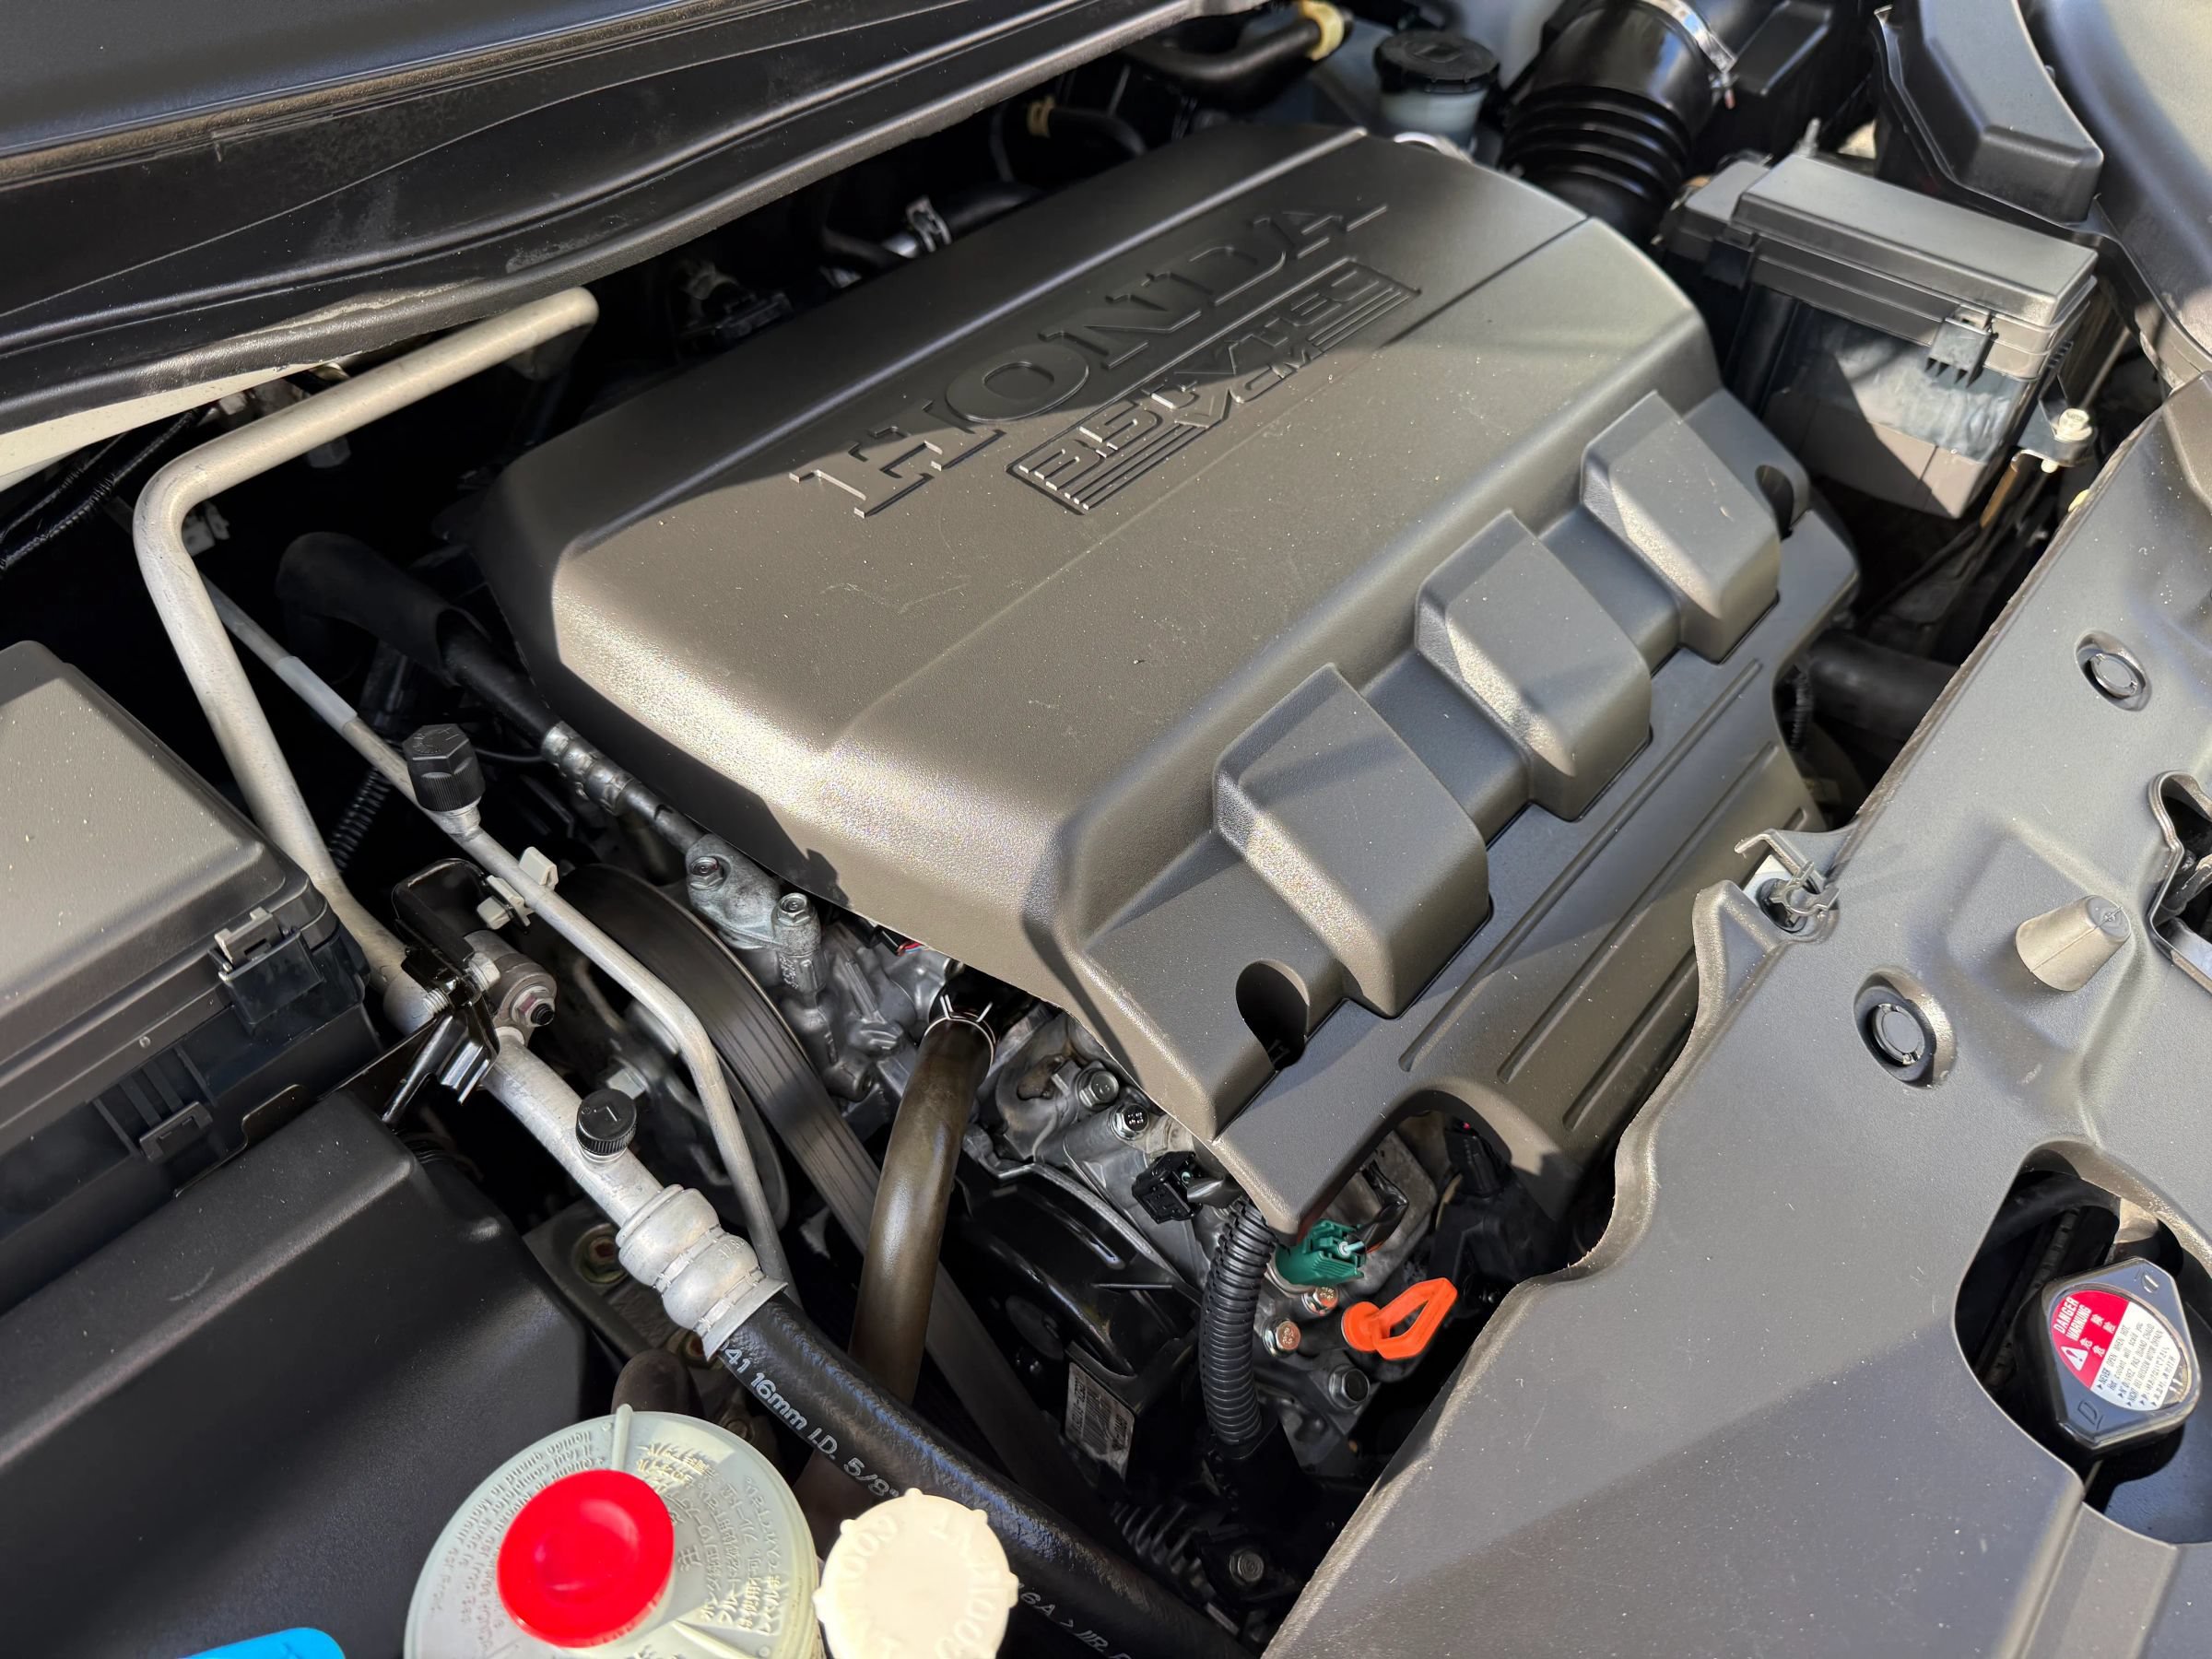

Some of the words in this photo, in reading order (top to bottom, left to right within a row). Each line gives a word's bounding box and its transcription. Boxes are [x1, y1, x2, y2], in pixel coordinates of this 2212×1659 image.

[789, 206, 1388, 518] HONDA
[2053, 1297, 2080, 1334] DANGER
[2065, 1303, 2093, 1341] WARNUNG
[749, 1372, 808, 1430] 16mm
[807, 1428, 841, 1461] I.D.
[843, 1457, 900, 1499] 5/8"
